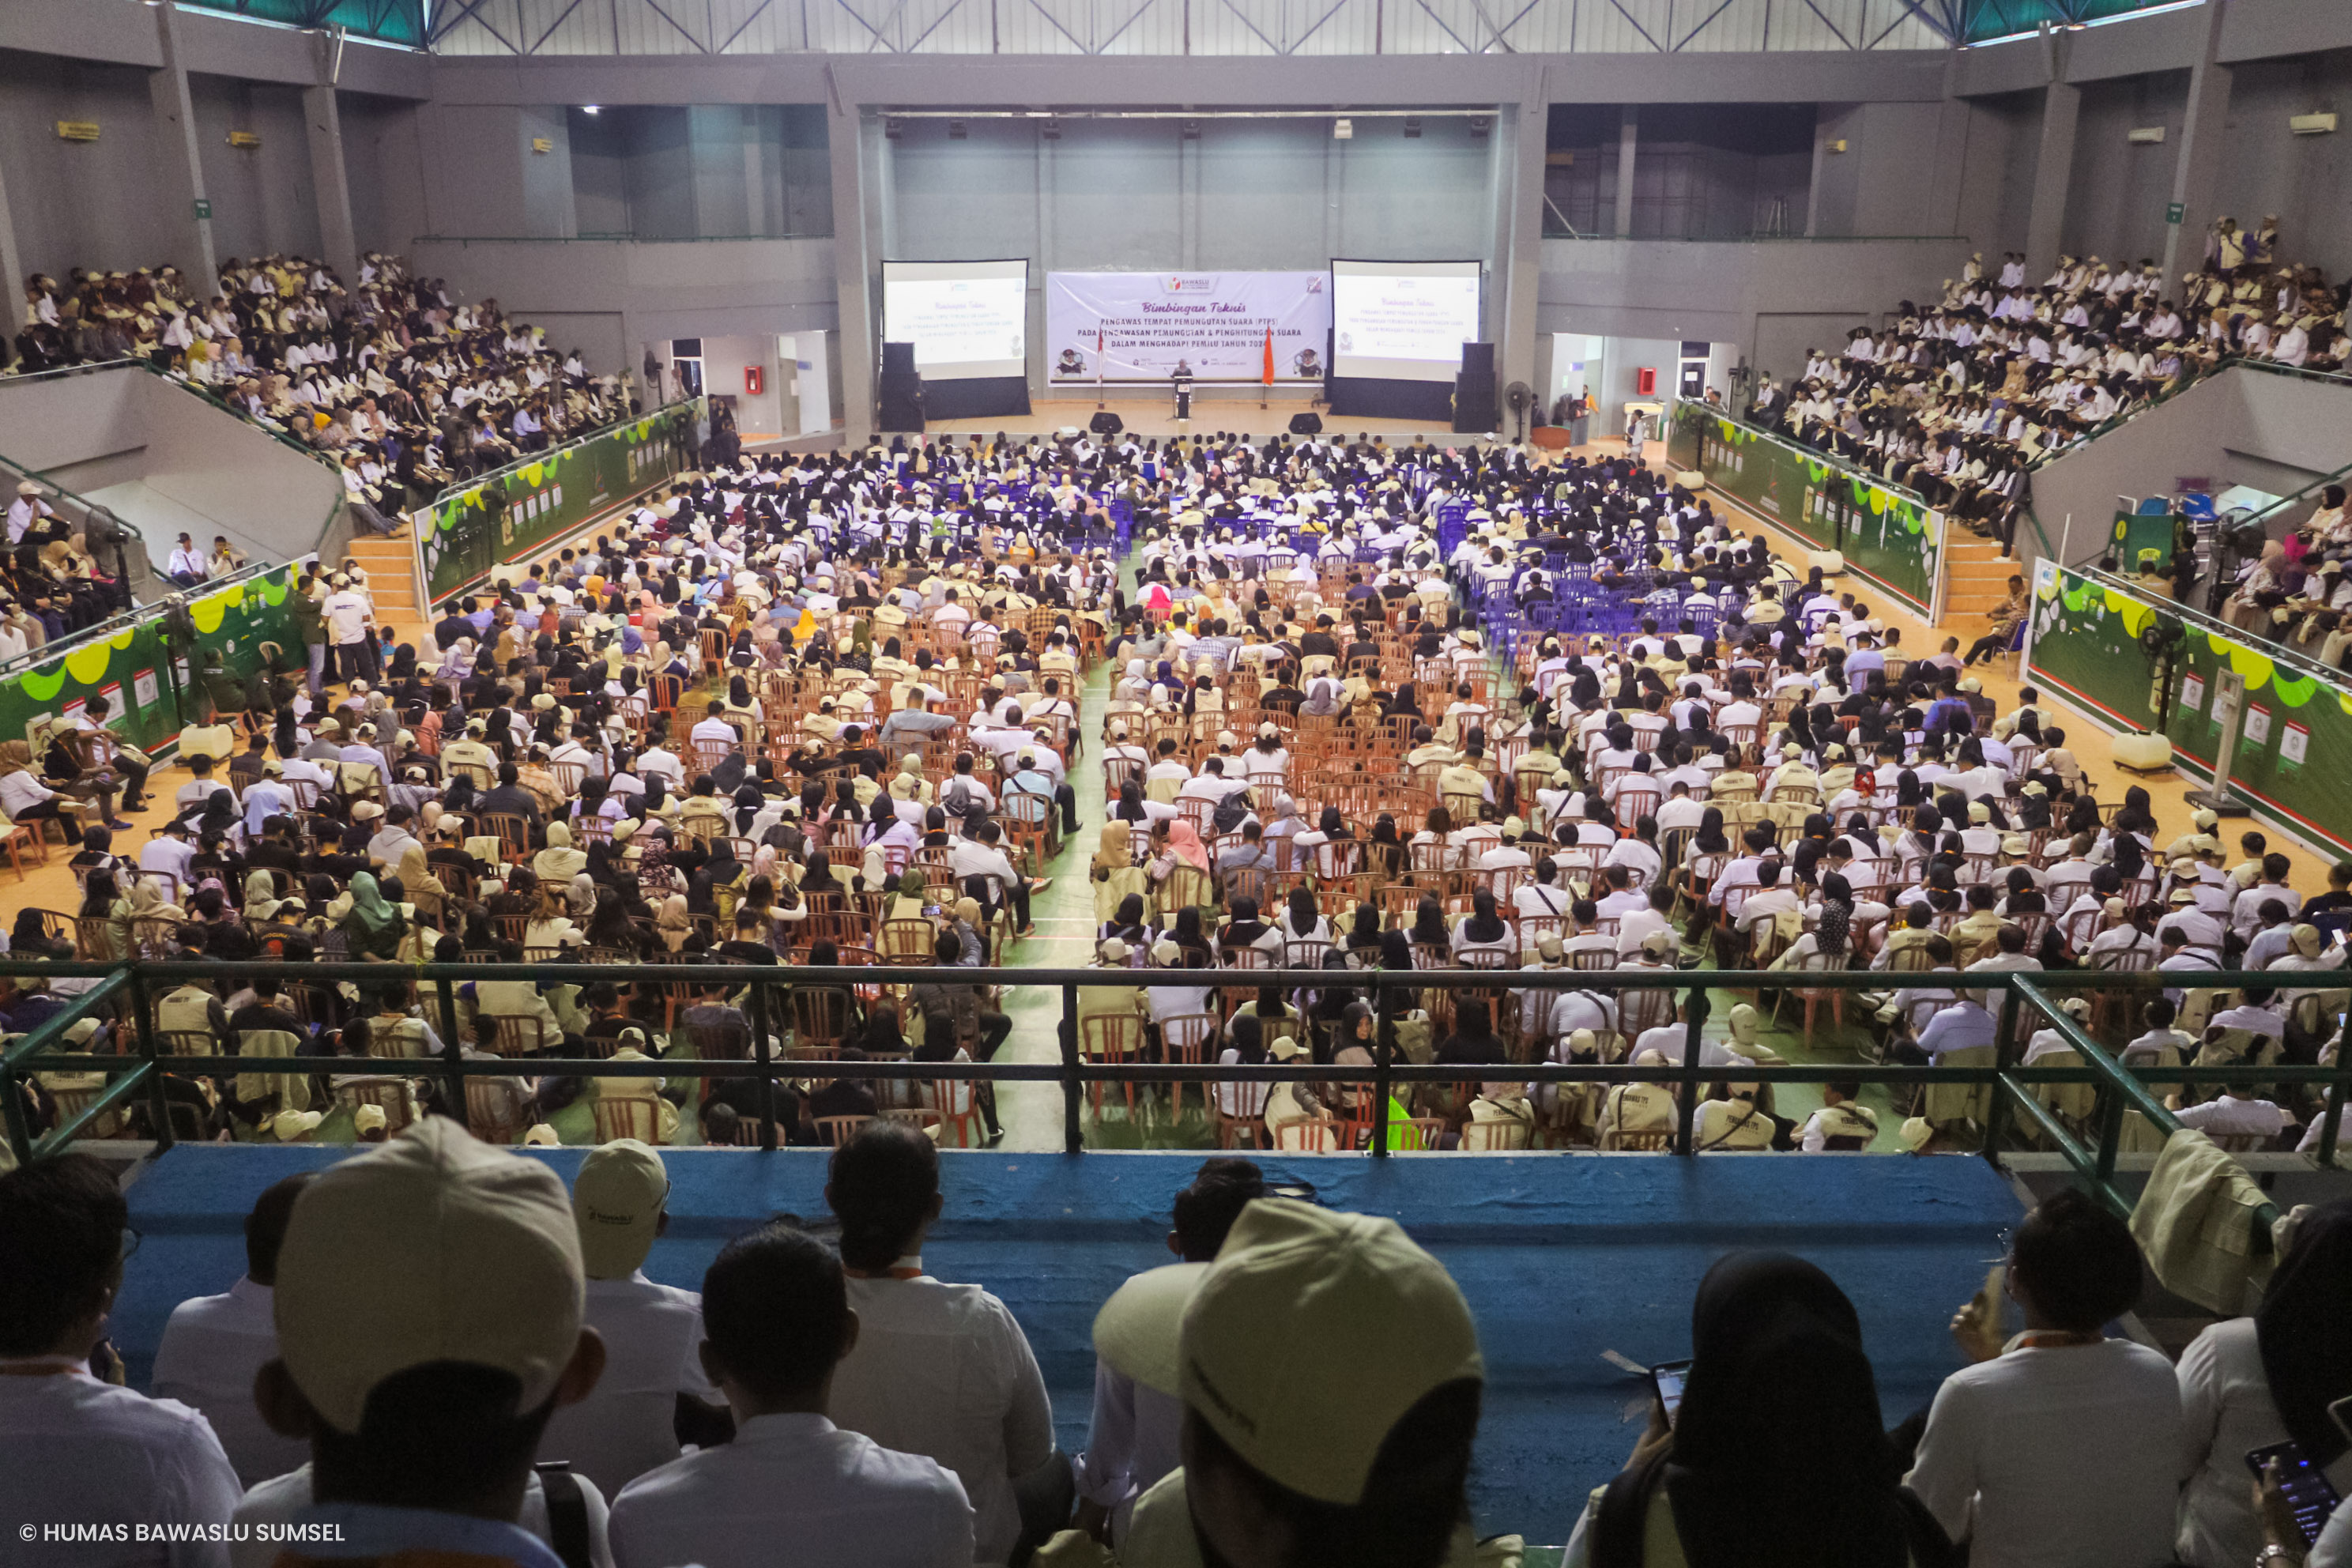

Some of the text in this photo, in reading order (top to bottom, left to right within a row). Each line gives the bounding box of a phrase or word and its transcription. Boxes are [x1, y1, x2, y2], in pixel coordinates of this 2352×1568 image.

[1142, 302, 1246, 315] Bimbingan Teknis
[1256, 318, 1278, 326] (PTPS)
